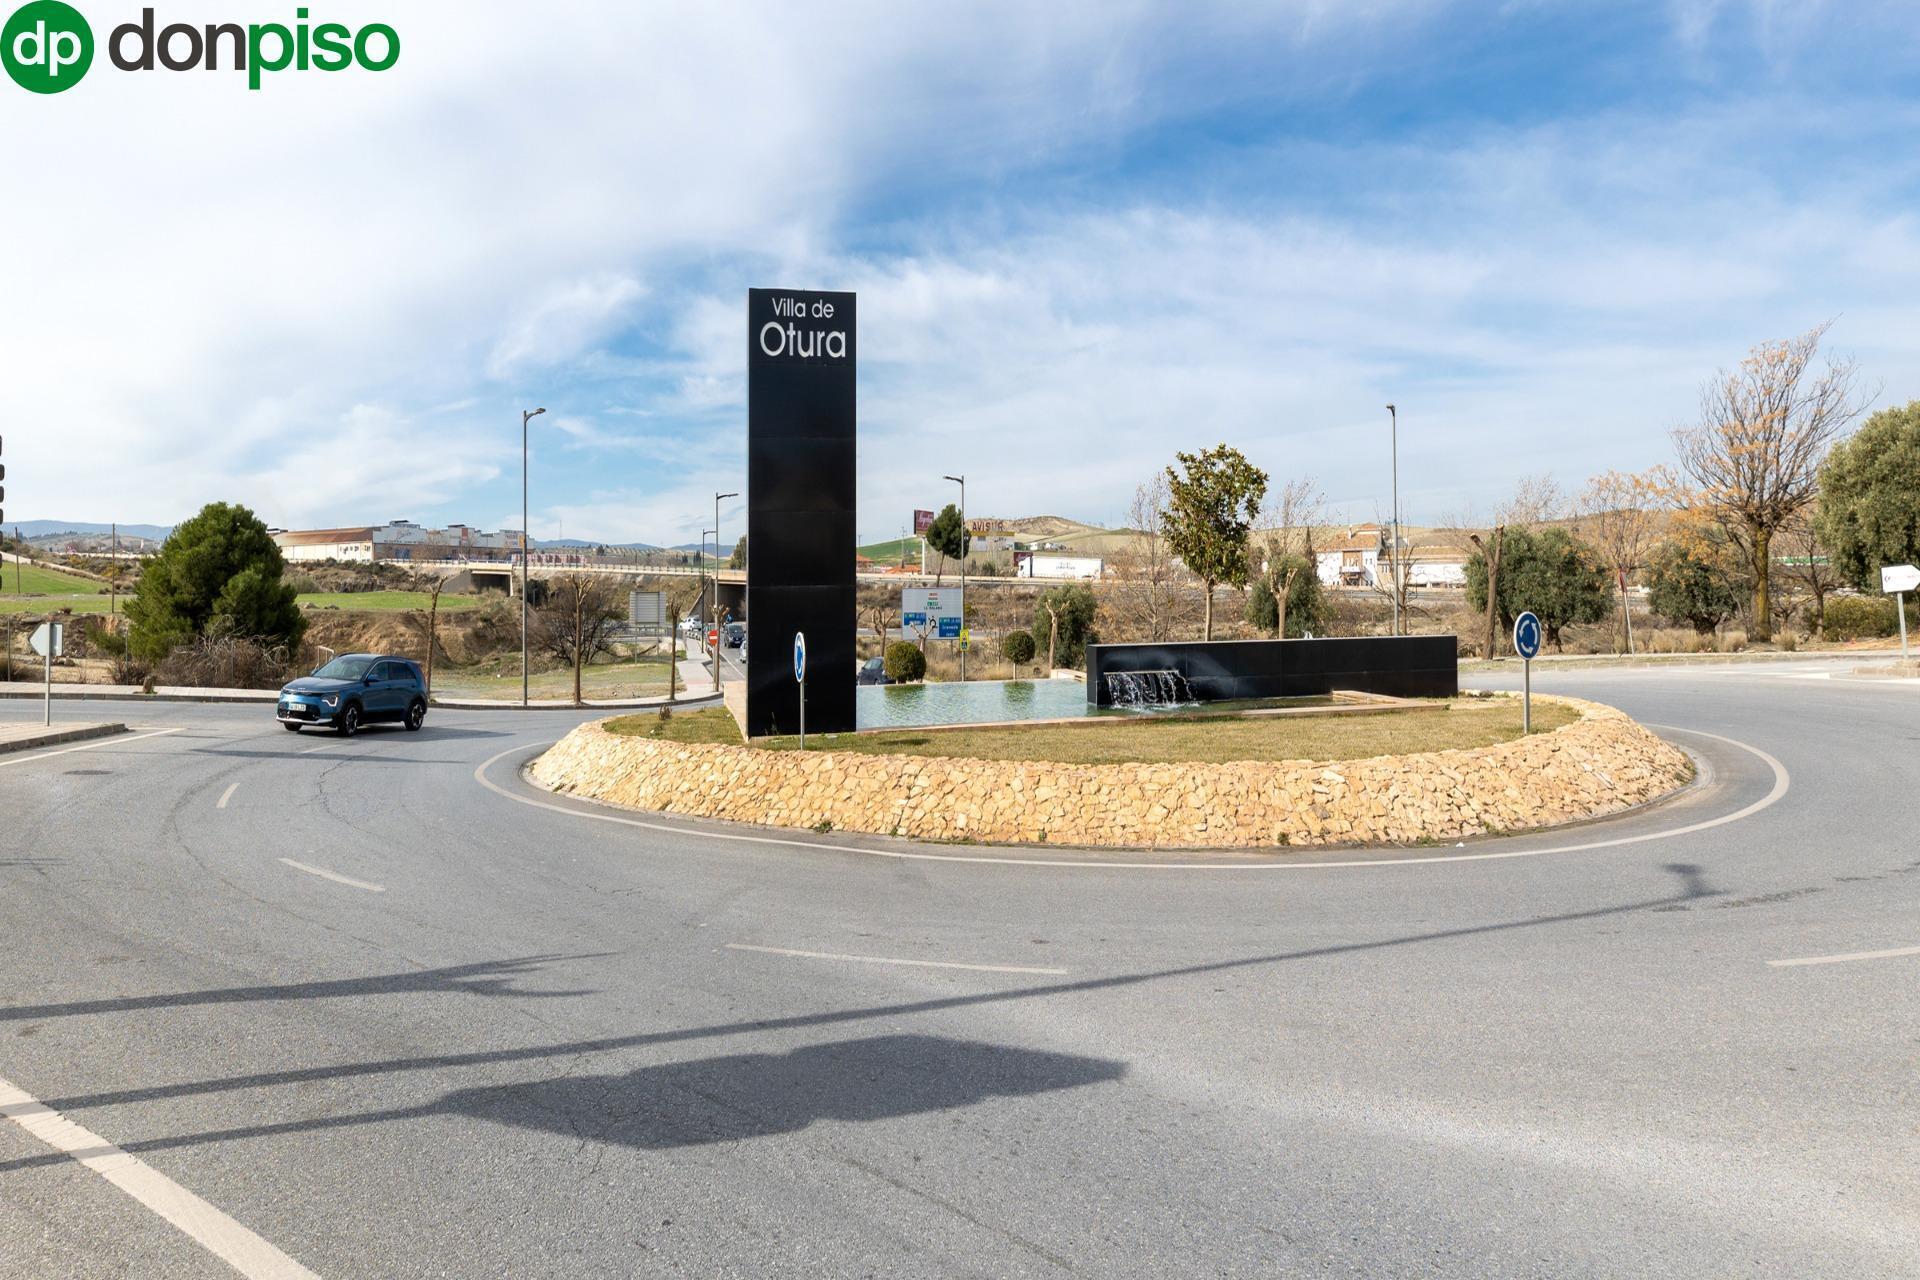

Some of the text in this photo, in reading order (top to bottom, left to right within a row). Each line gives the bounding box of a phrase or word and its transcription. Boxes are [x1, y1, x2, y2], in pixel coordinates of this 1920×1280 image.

[771, 297, 834, 319] Villa de
[760, 321, 846, 358] Otura
